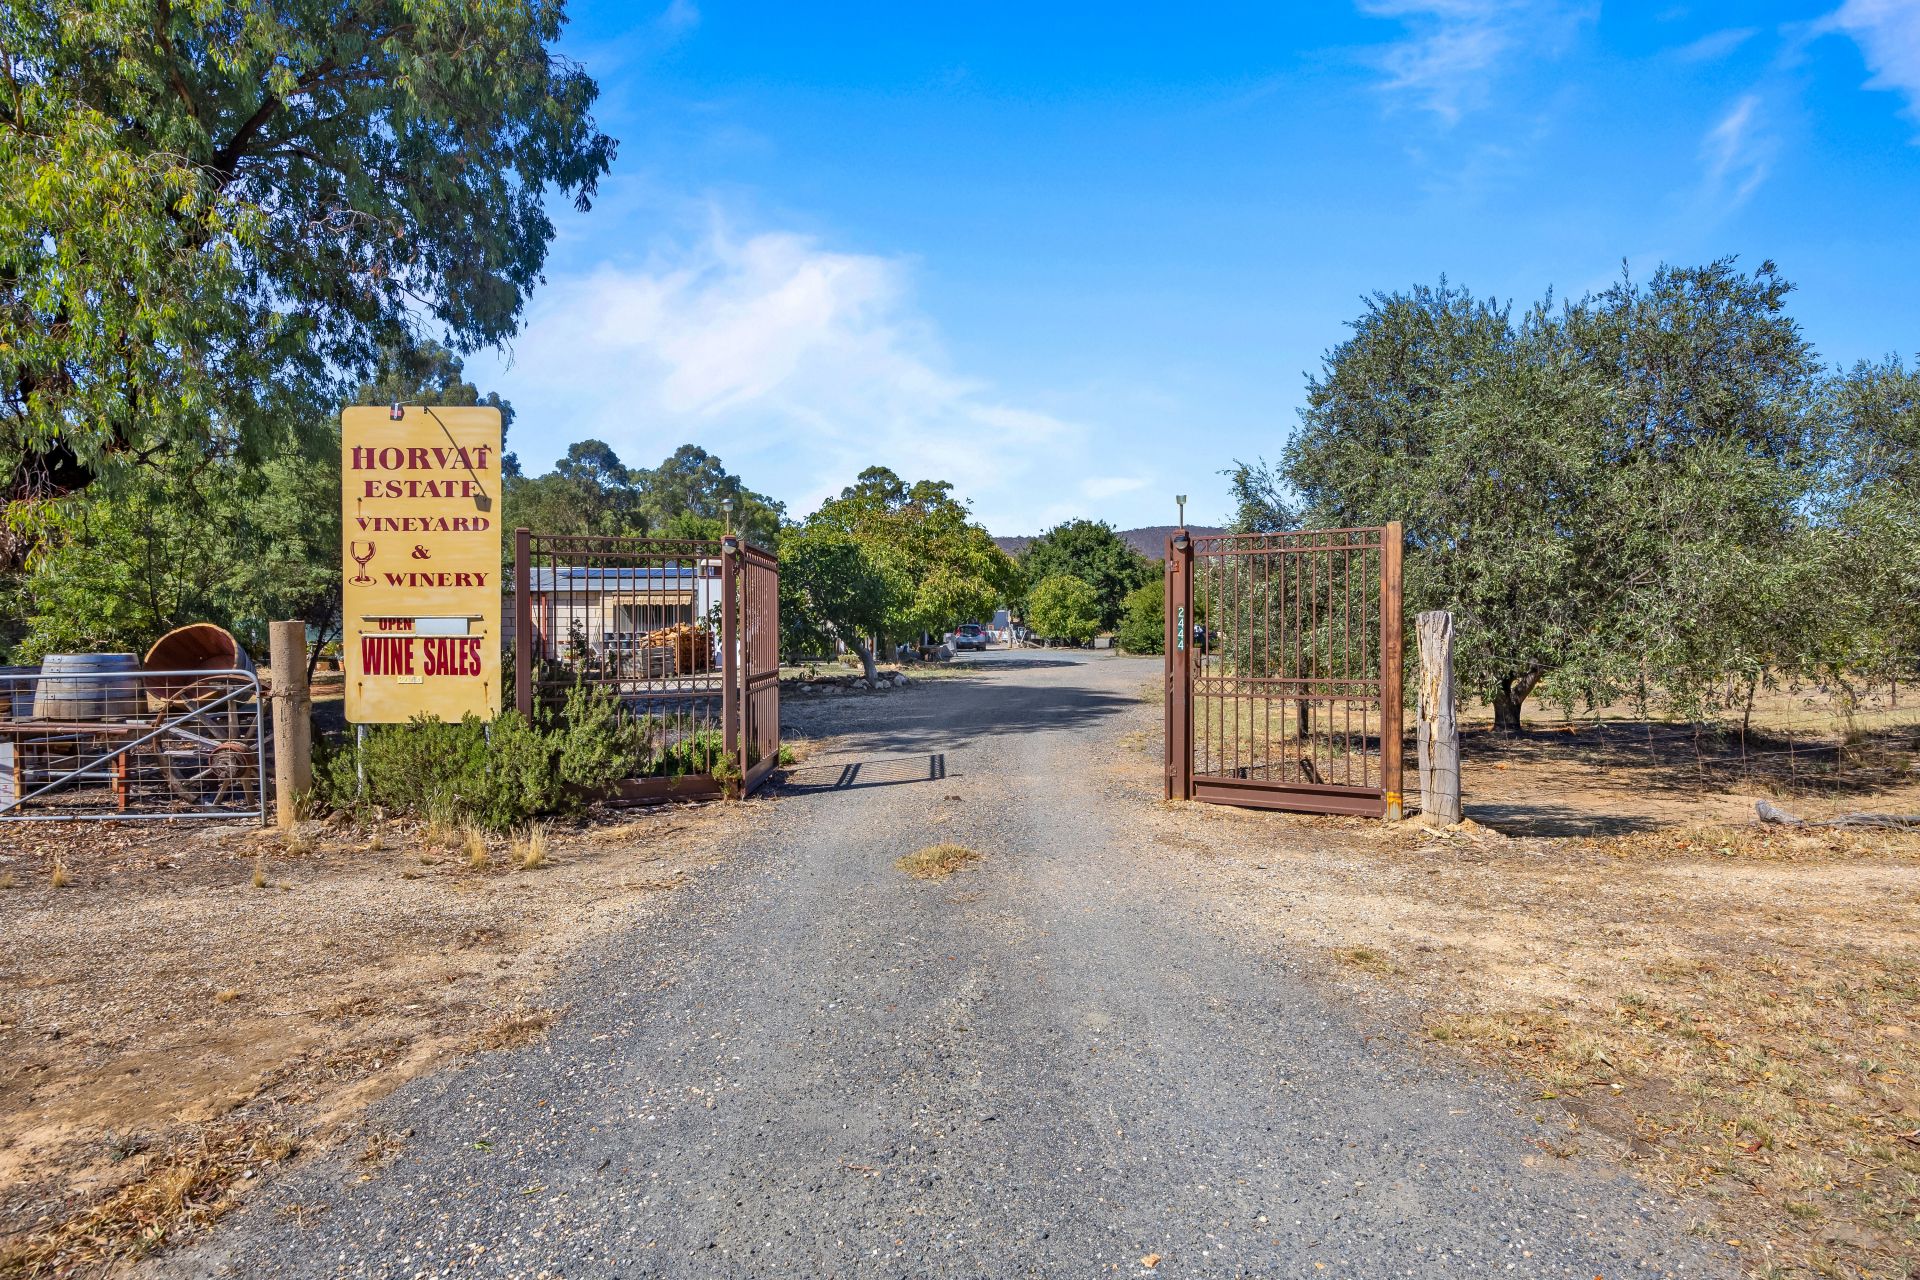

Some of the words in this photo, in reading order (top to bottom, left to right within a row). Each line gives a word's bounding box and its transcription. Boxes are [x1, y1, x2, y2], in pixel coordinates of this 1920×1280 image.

[351, 447, 492, 470] HORVAT
[364, 480, 479, 498] ESTATE
[356, 517, 490, 532] VINEYARD
[411, 545, 432, 560] &
[384, 573, 489, 587] WINERY
[378, 618, 412, 631] OPEN
[1177, 607, 1185, 650] 2444
[361, 638, 415, 676] WINE
[423, 638, 481, 677] SALES
